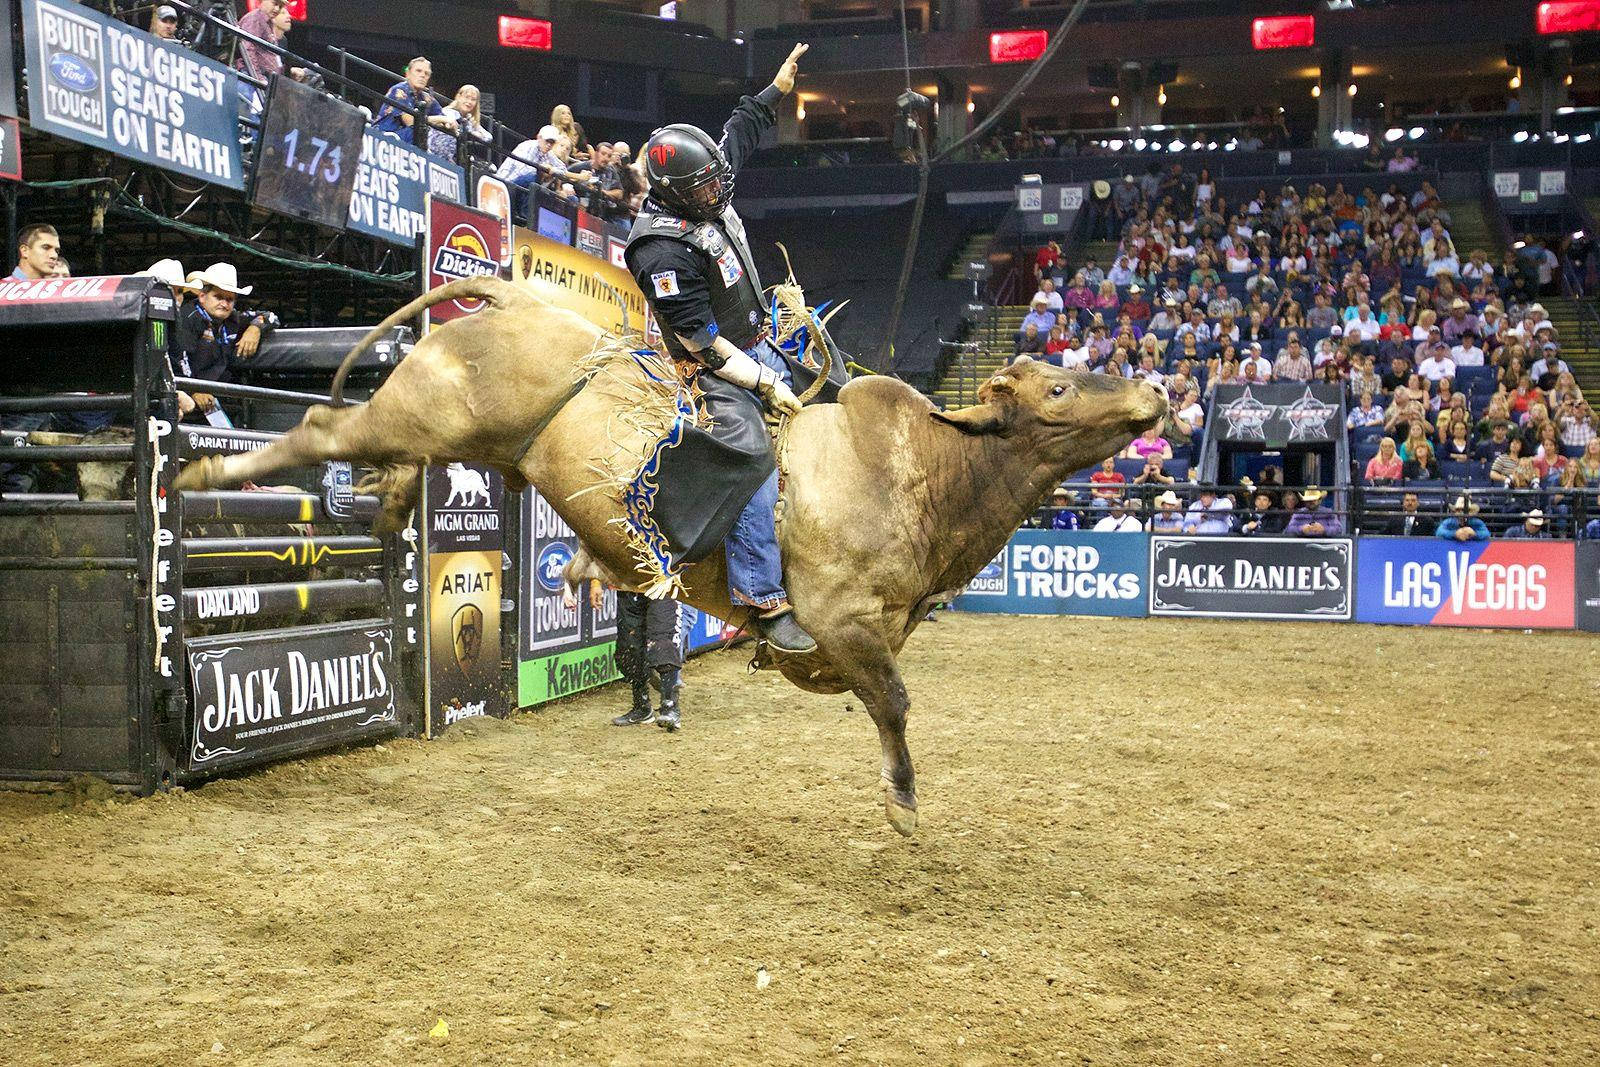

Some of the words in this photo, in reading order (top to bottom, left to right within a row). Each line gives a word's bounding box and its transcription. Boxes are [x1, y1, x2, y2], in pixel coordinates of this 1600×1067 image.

[43, 11, 98, 60] BUILT
[61, 60, 87, 84] Ford
[107, 26, 226, 105] TOUGHEST
[48, 84, 102, 126] TOUGH
[111, 68, 185, 127] SEATS
[112, 108, 148, 153] ON
[155, 122, 231, 179] EARTH
[284, 128, 342, 183] 1.73
[360, 133, 426, 184] UGHEST
[432, 169, 457, 200] BUILT
[349, 191, 374, 227] ON
[440, 252, 494, 276] Dickies
[534, 259, 576, 289] ARIAT
[0, 279, 63, 300] UCAS
[61, 278, 108, 298] OIL
[198, 436, 228, 449] ARIAT
[229, 438, 275, 451] INVITATIO
[434, 513, 463, 531] MGM
[464, 513, 499, 531] GRAND
[1012, 545, 1099, 571] FORD
[1158, 558, 1225, 588] JACK
[1234, 559, 1341, 592] DANIEL'S
[401, 527, 419, 643] efert
[441, 572, 493, 595] ARIAT
[968, 578, 1003, 590] OUGH
[1012, 571, 1140, 599] TRUCKS
[1384, 560, 1441, 608] LAS
[1447, 550, 1547, 615] VEGAS
[197, 588, 260, 619] OAKLAND
[203, 661, 282, 732] JACK
[287, 641, 388, 715] DANIEL'S
[545, 644, 617, 697] Kawasak
